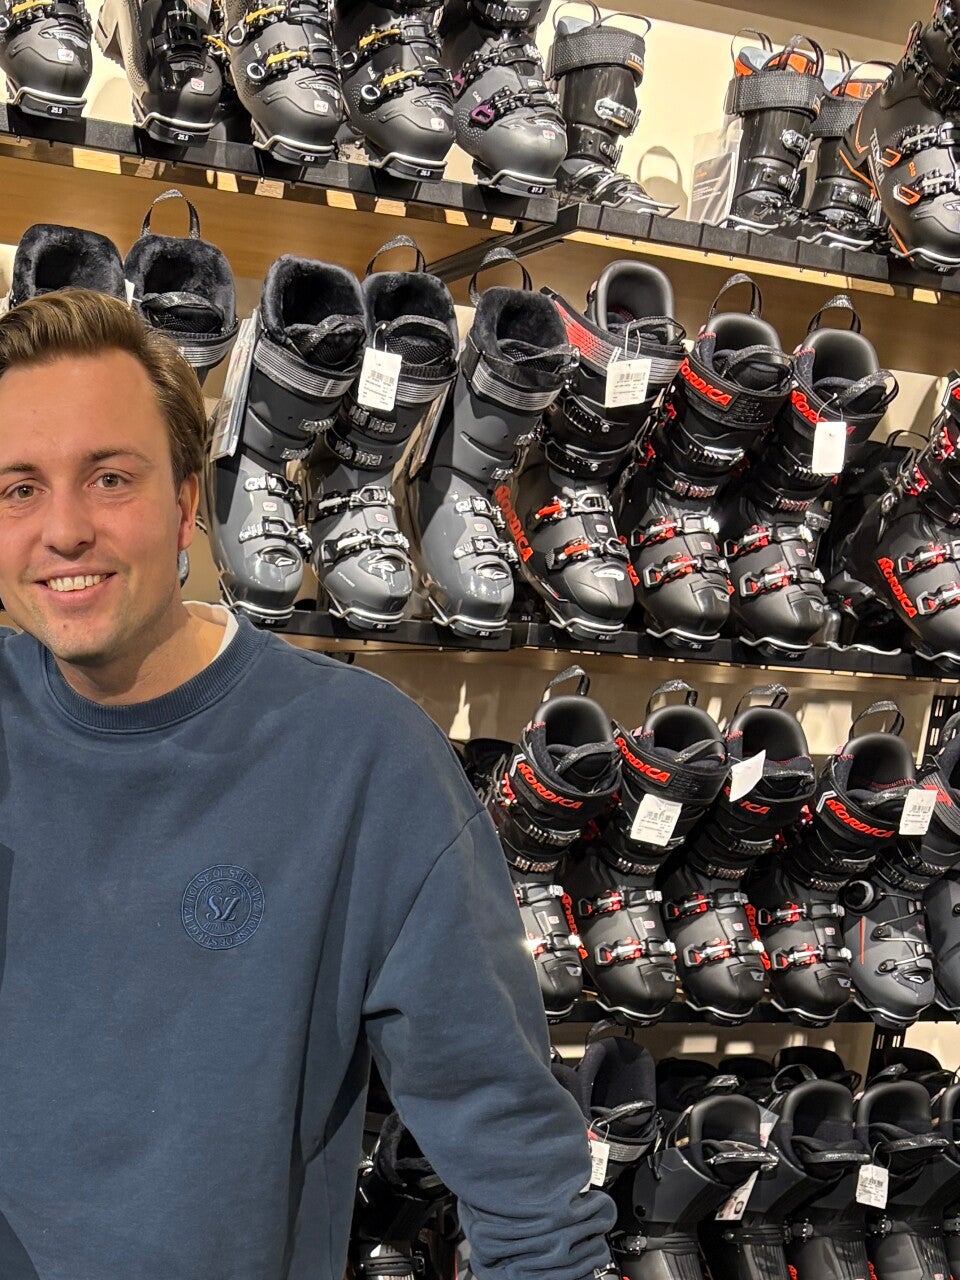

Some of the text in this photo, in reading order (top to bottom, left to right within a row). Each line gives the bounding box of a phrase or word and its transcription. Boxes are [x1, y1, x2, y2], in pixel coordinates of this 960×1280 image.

[494, 484, 534, 562] NORDICA
[878, 557, 918, 618] NORDICA
[615, 736, 671, 783] NORDICA
[517, 762, 584, 809] NORDICA
[825, 798, 895, 838] NORDICA
